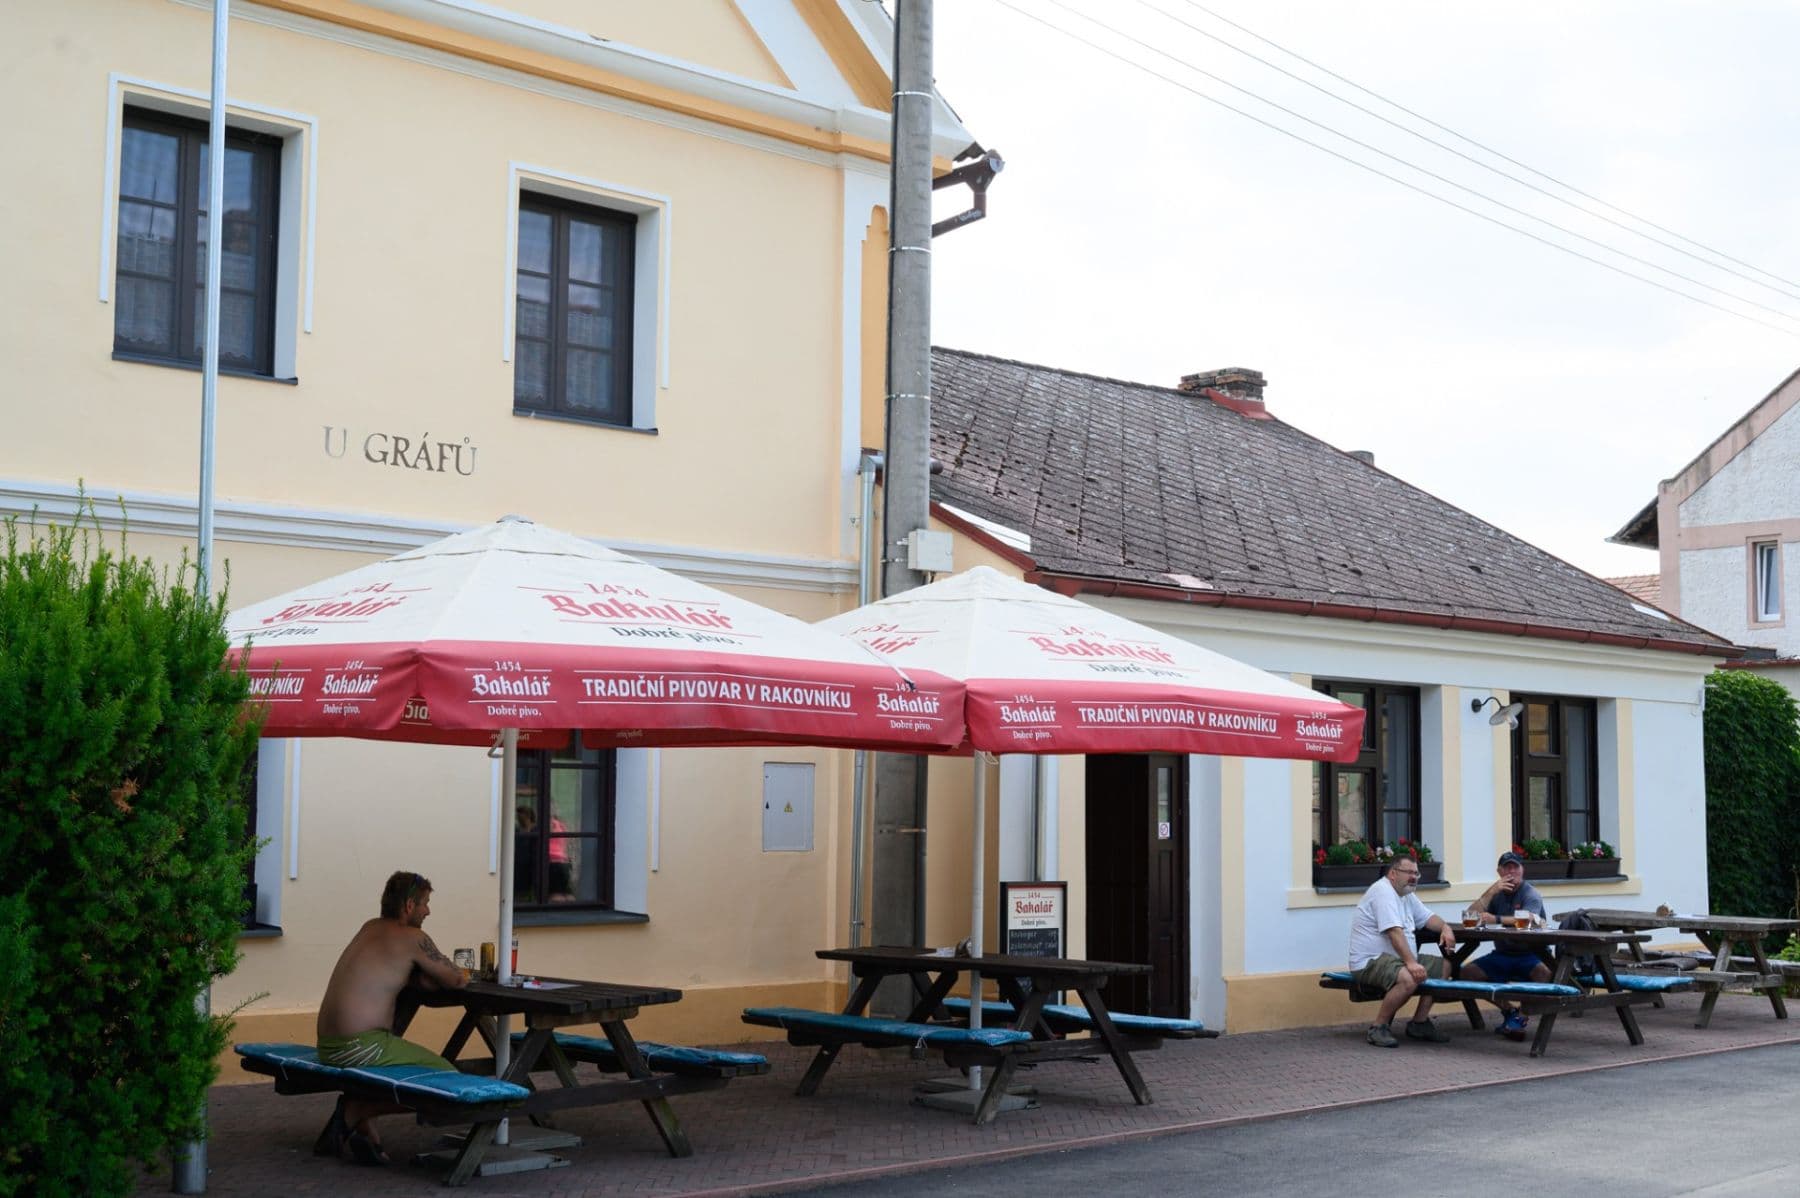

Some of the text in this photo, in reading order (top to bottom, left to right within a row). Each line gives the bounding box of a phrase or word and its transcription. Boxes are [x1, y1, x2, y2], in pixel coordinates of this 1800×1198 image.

[323, 426, 477, 476] U GRÁFŮ
[542, 594, 733, 629] Bakalář
[610, 626, 681, 639] Dobré
[1027, 636, 1175, 665] Bakalář
[494, 660, 522, 672] 1454
[247, 672, 305, 695] AKOVNÍKU
[321, 674, 378, 694] Bakalář
[471, 673, 552, 696] Bakalář
[582, 675, 851, 709] TRADIČNÍ PIVOVAR V RAKOVNÍKU
[322, 702, 343, 715] Dobré
[876, 692, 940, 714] Bakalář
[1015, 694, 1034, 704] 1454
[487, 704, 542, 719] Dobré pivo.
[1000, 705, 1057, 723] Bakalář
[1078, 704, 1277, 734] TRADIČNÍ PIVOVAR V RAKOVNÍKU
[890, 719, 933, 732] Dobré pivo.
[1012, 730, 1034, 740] Dobré
[1296, 719, 1344, 739] Bakalář
[1015, 900, 1053, 914] Bakalář
